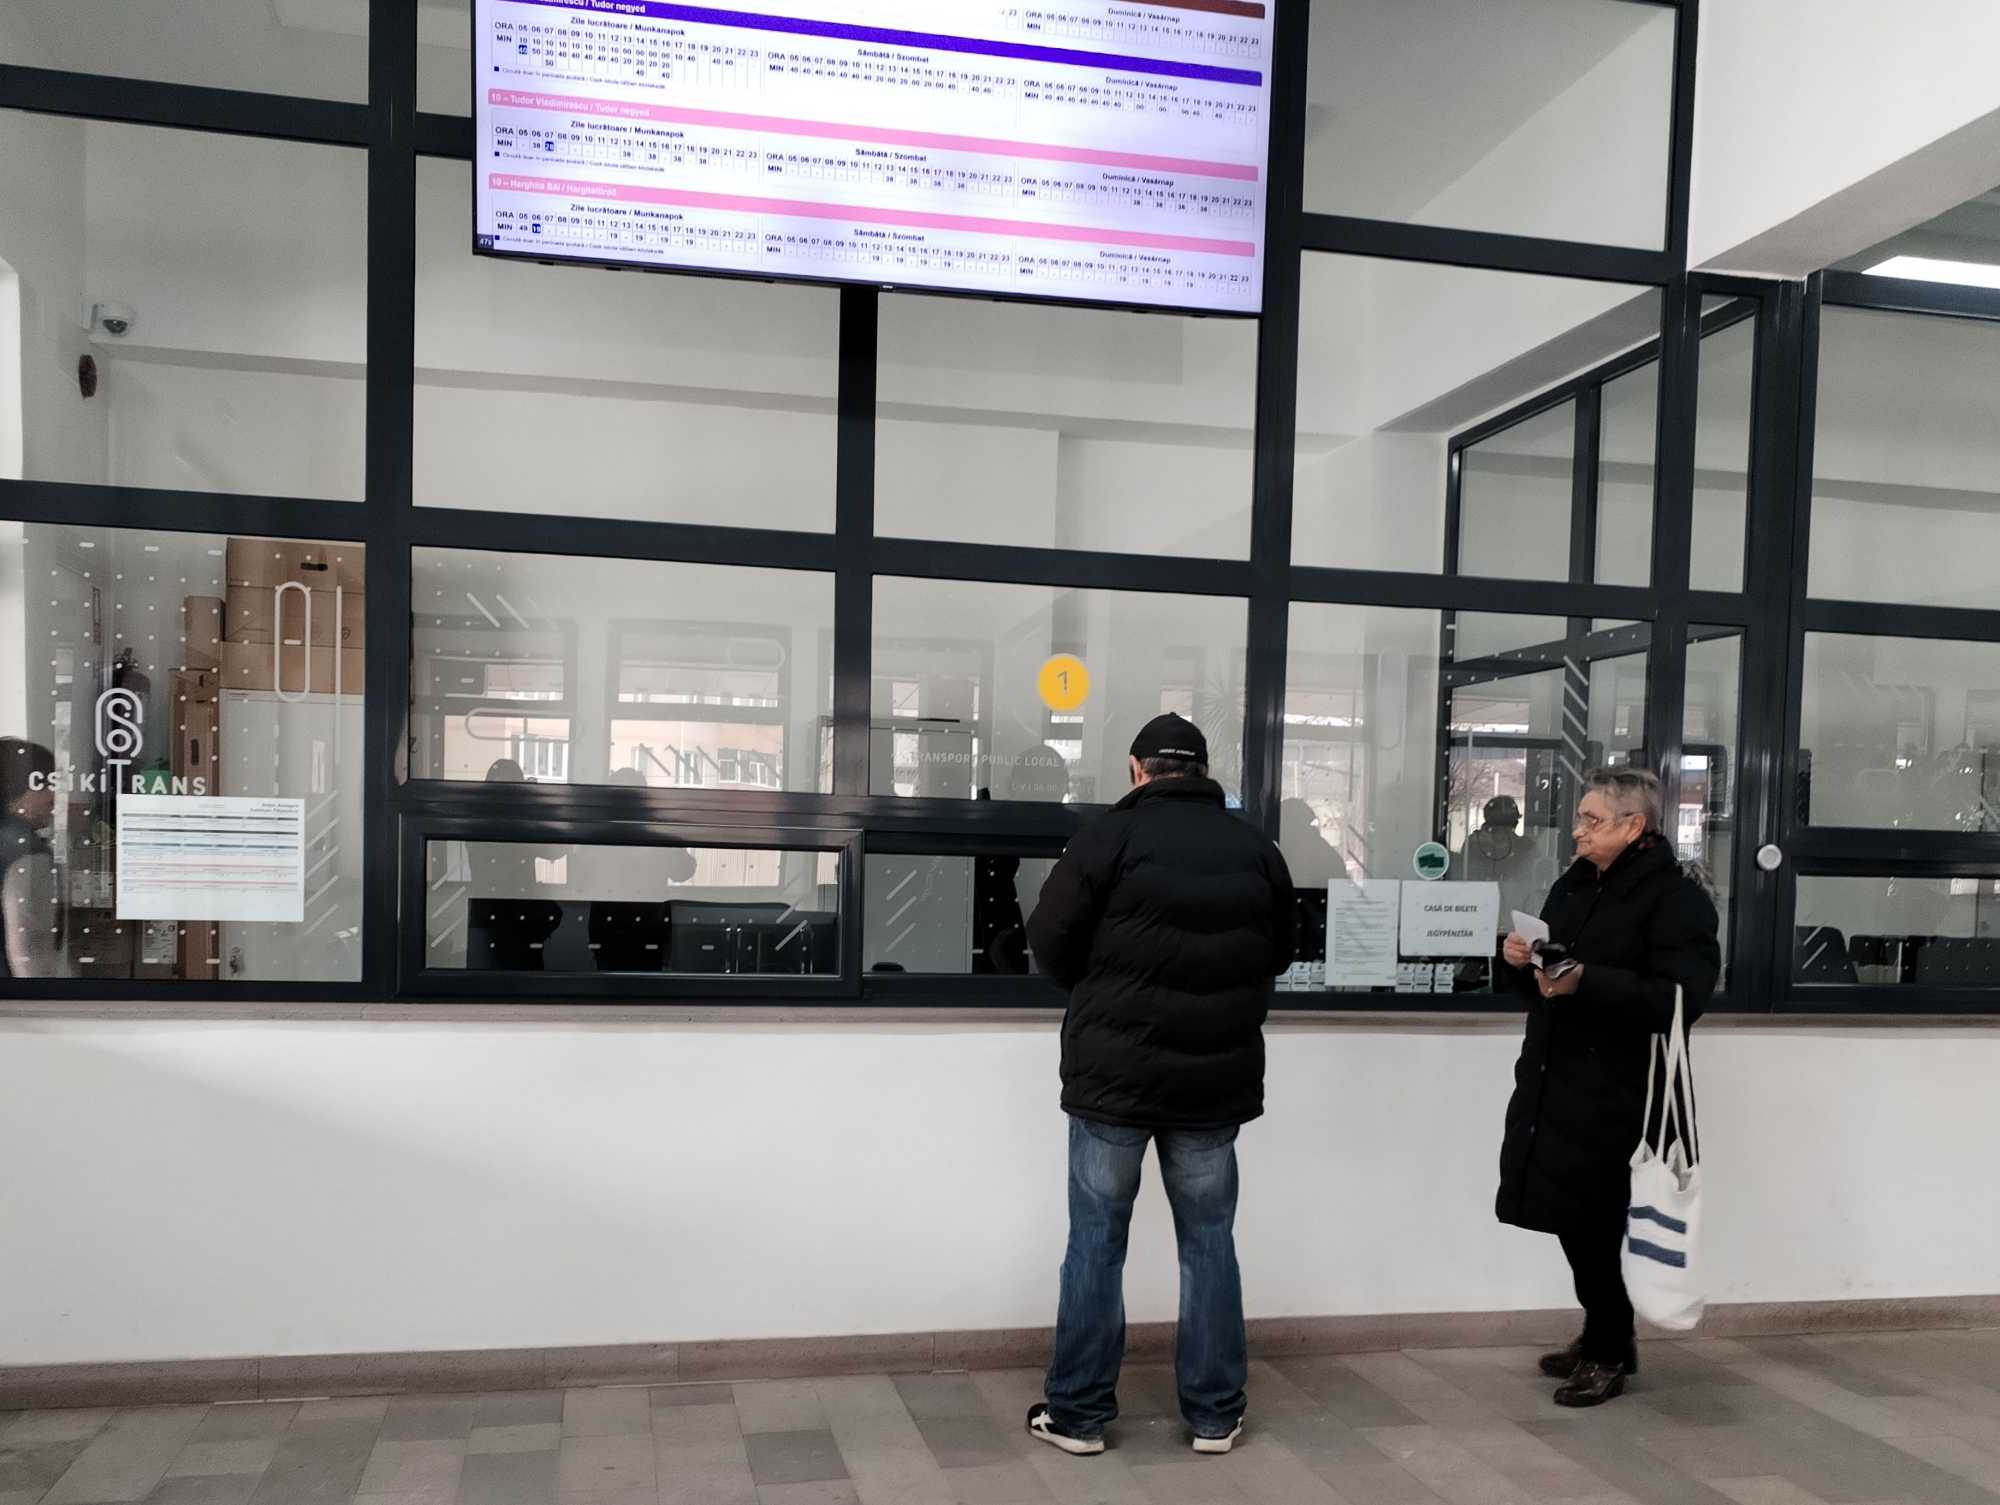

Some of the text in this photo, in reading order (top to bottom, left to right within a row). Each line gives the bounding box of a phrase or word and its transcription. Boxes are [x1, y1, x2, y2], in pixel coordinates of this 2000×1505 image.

[591, 0, 614, 9] Tudor
[615, 3, 646, 13] negyed
[1025, 10, 1042, 19] ORA
[494, 21, 514, 31] ORA
[570, 17, 585, 25] Zile
[635, 24, 685, 36] Munkanapok
[1027, 22, 1041, 31] MIN
[496, 34, 512, 44] MIN
[767, 51, 786, 60] ORA
[769, 64, 784, 73] MIN
[1023, 79, 1041, 88] ORA
[511, 95, 534, 105] Tudor
[1025, 92, 1039, 100] MIN
[495, 126, 514, 136] ORA
[570, 120, 585, 129] Zile
[634, 127, 684, 140] Munkanapok
[497, 139, 513, 148] MIN
[766, 152, 784, 162] ORA
[767, 165, 782, 174] MIN
[1020, 177, 1038, 186] ORA
[1022, 189, 1036, 198] MIN
[495, 210, 515, 219] ORA
[570, 203, 585, 212] Zile
[633, 210, 683, 223] Munkanapok
[497, 223, 513, 232] MIN
[765, 234, 783, 243] ORA
[766, 246, 781, 254] MIN
[1018, 256, 1035, 264] ORA
[1019, 267, 1034, 276] MIN
[1058, 670, 1069, 692] 1
